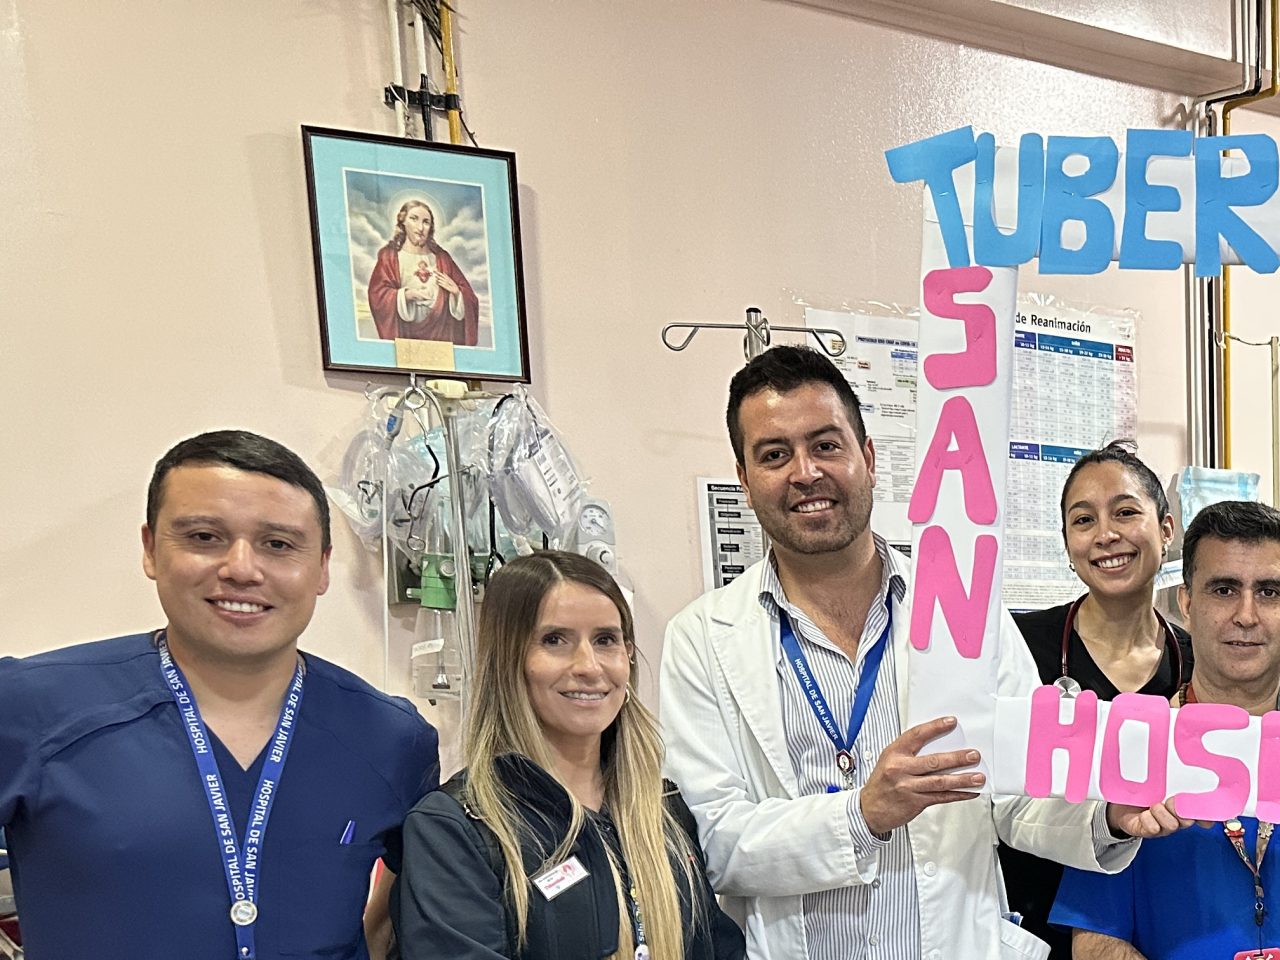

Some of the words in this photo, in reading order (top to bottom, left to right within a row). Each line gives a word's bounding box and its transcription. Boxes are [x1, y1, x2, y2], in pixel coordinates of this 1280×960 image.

[1031, 314, 1091, 333] Reanimación
[907, 266, 997, 659] SAN
[159, 641, 173, 668] JAVIE
[166, 669, 183, 690] SAN
[176, 690, 191, 704] DE
[287, 693, 299, 708] DE
[795, 658, 813, 690] HOSPITAL
[809, 689, 819, 700] DE
[814, 700, 826, 716] SAN
[822, 715, 838, 740] JAVIER
[183, 705, 208, 754] HOSPITAL
[281, 707, 295, 728] SAN
[270, 727, 289, 763] JAVIER
[206, 774, 226, 811] JAVIER
[252, 779, 274, 825] HOSPITAL
[217, 813, 231, 837] SAN
[248, 828, 261, 845] DE
[223, 838, 236, 853] DE
[245, 846, 257, 870] SAN
[228, 855, 245, 901] OSPITAL
